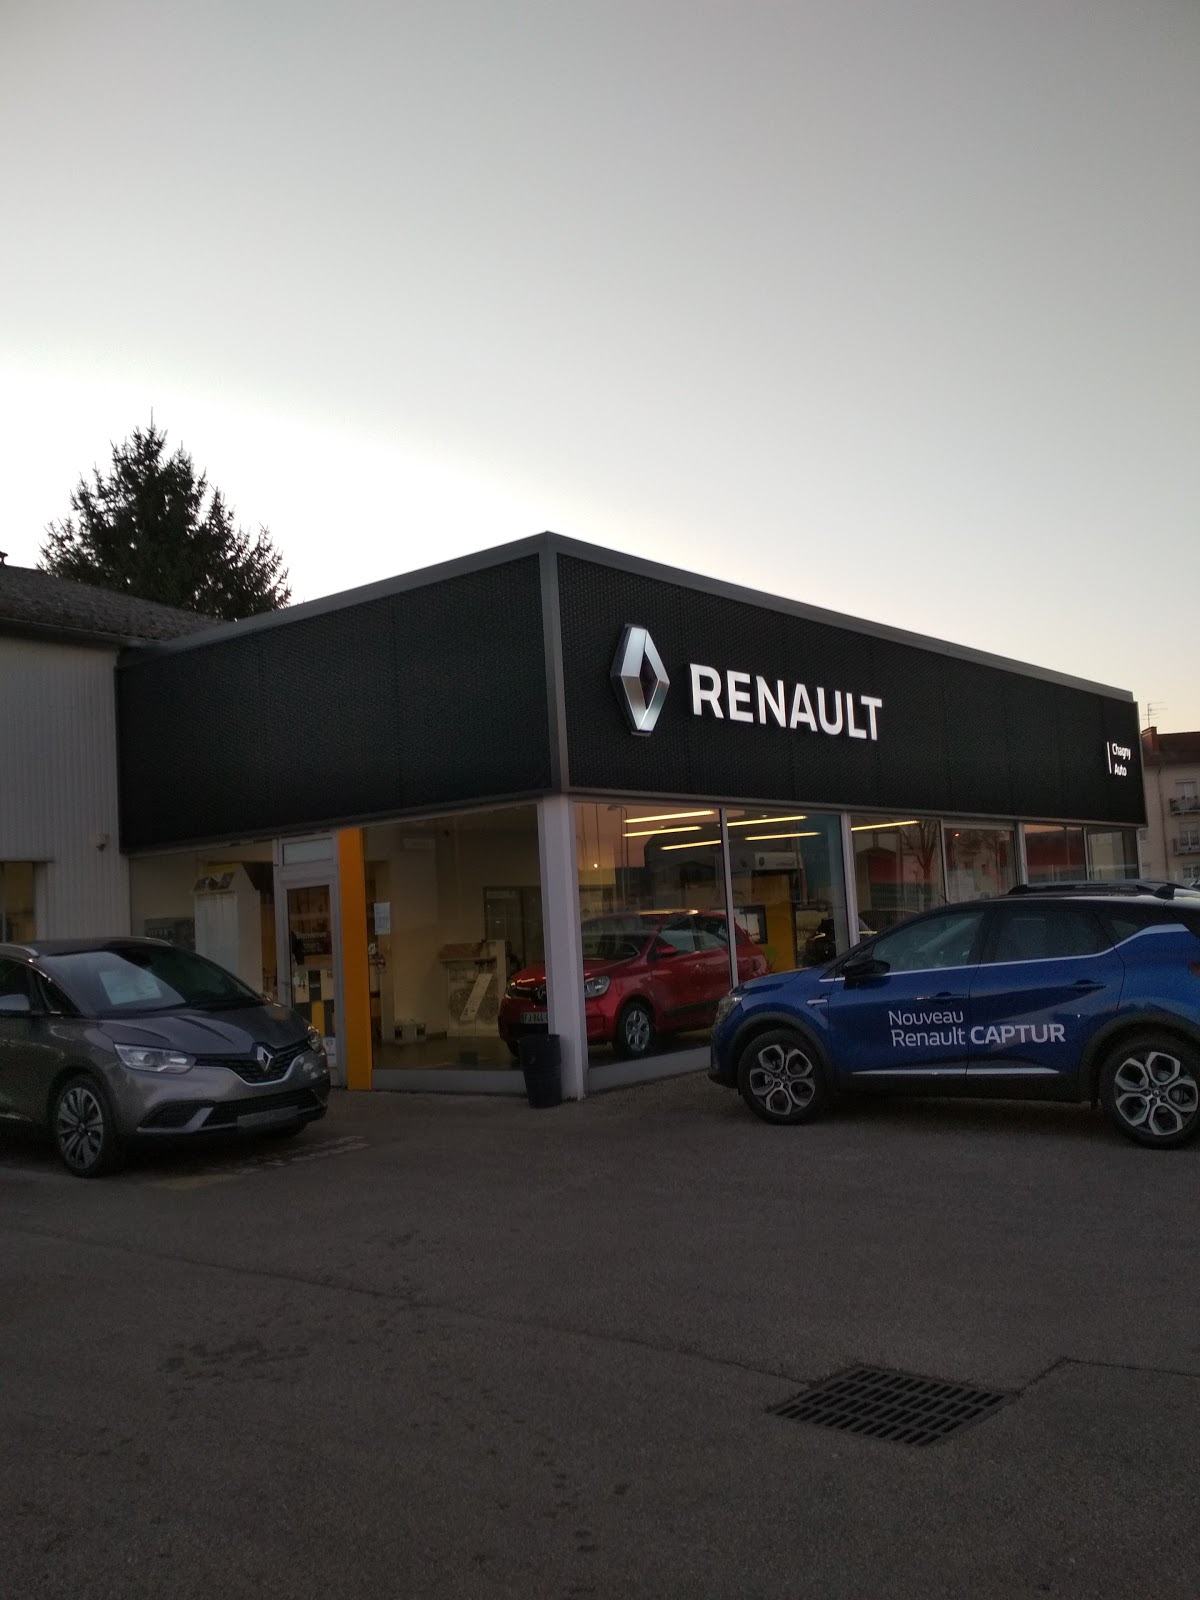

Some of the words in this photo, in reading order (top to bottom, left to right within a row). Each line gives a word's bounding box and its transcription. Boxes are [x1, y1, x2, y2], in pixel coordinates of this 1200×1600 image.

[690, 663, 883, 741] RENAULT
[1112, 743, 1131, 760] Chagny
[1114, 763, 1127, 777] Auto
[888, 1010, 964, 1025] Nouveau
[891, 1027, 966, 1047] Renault
[970, 1023, 1066, 1044] CAPTUR
